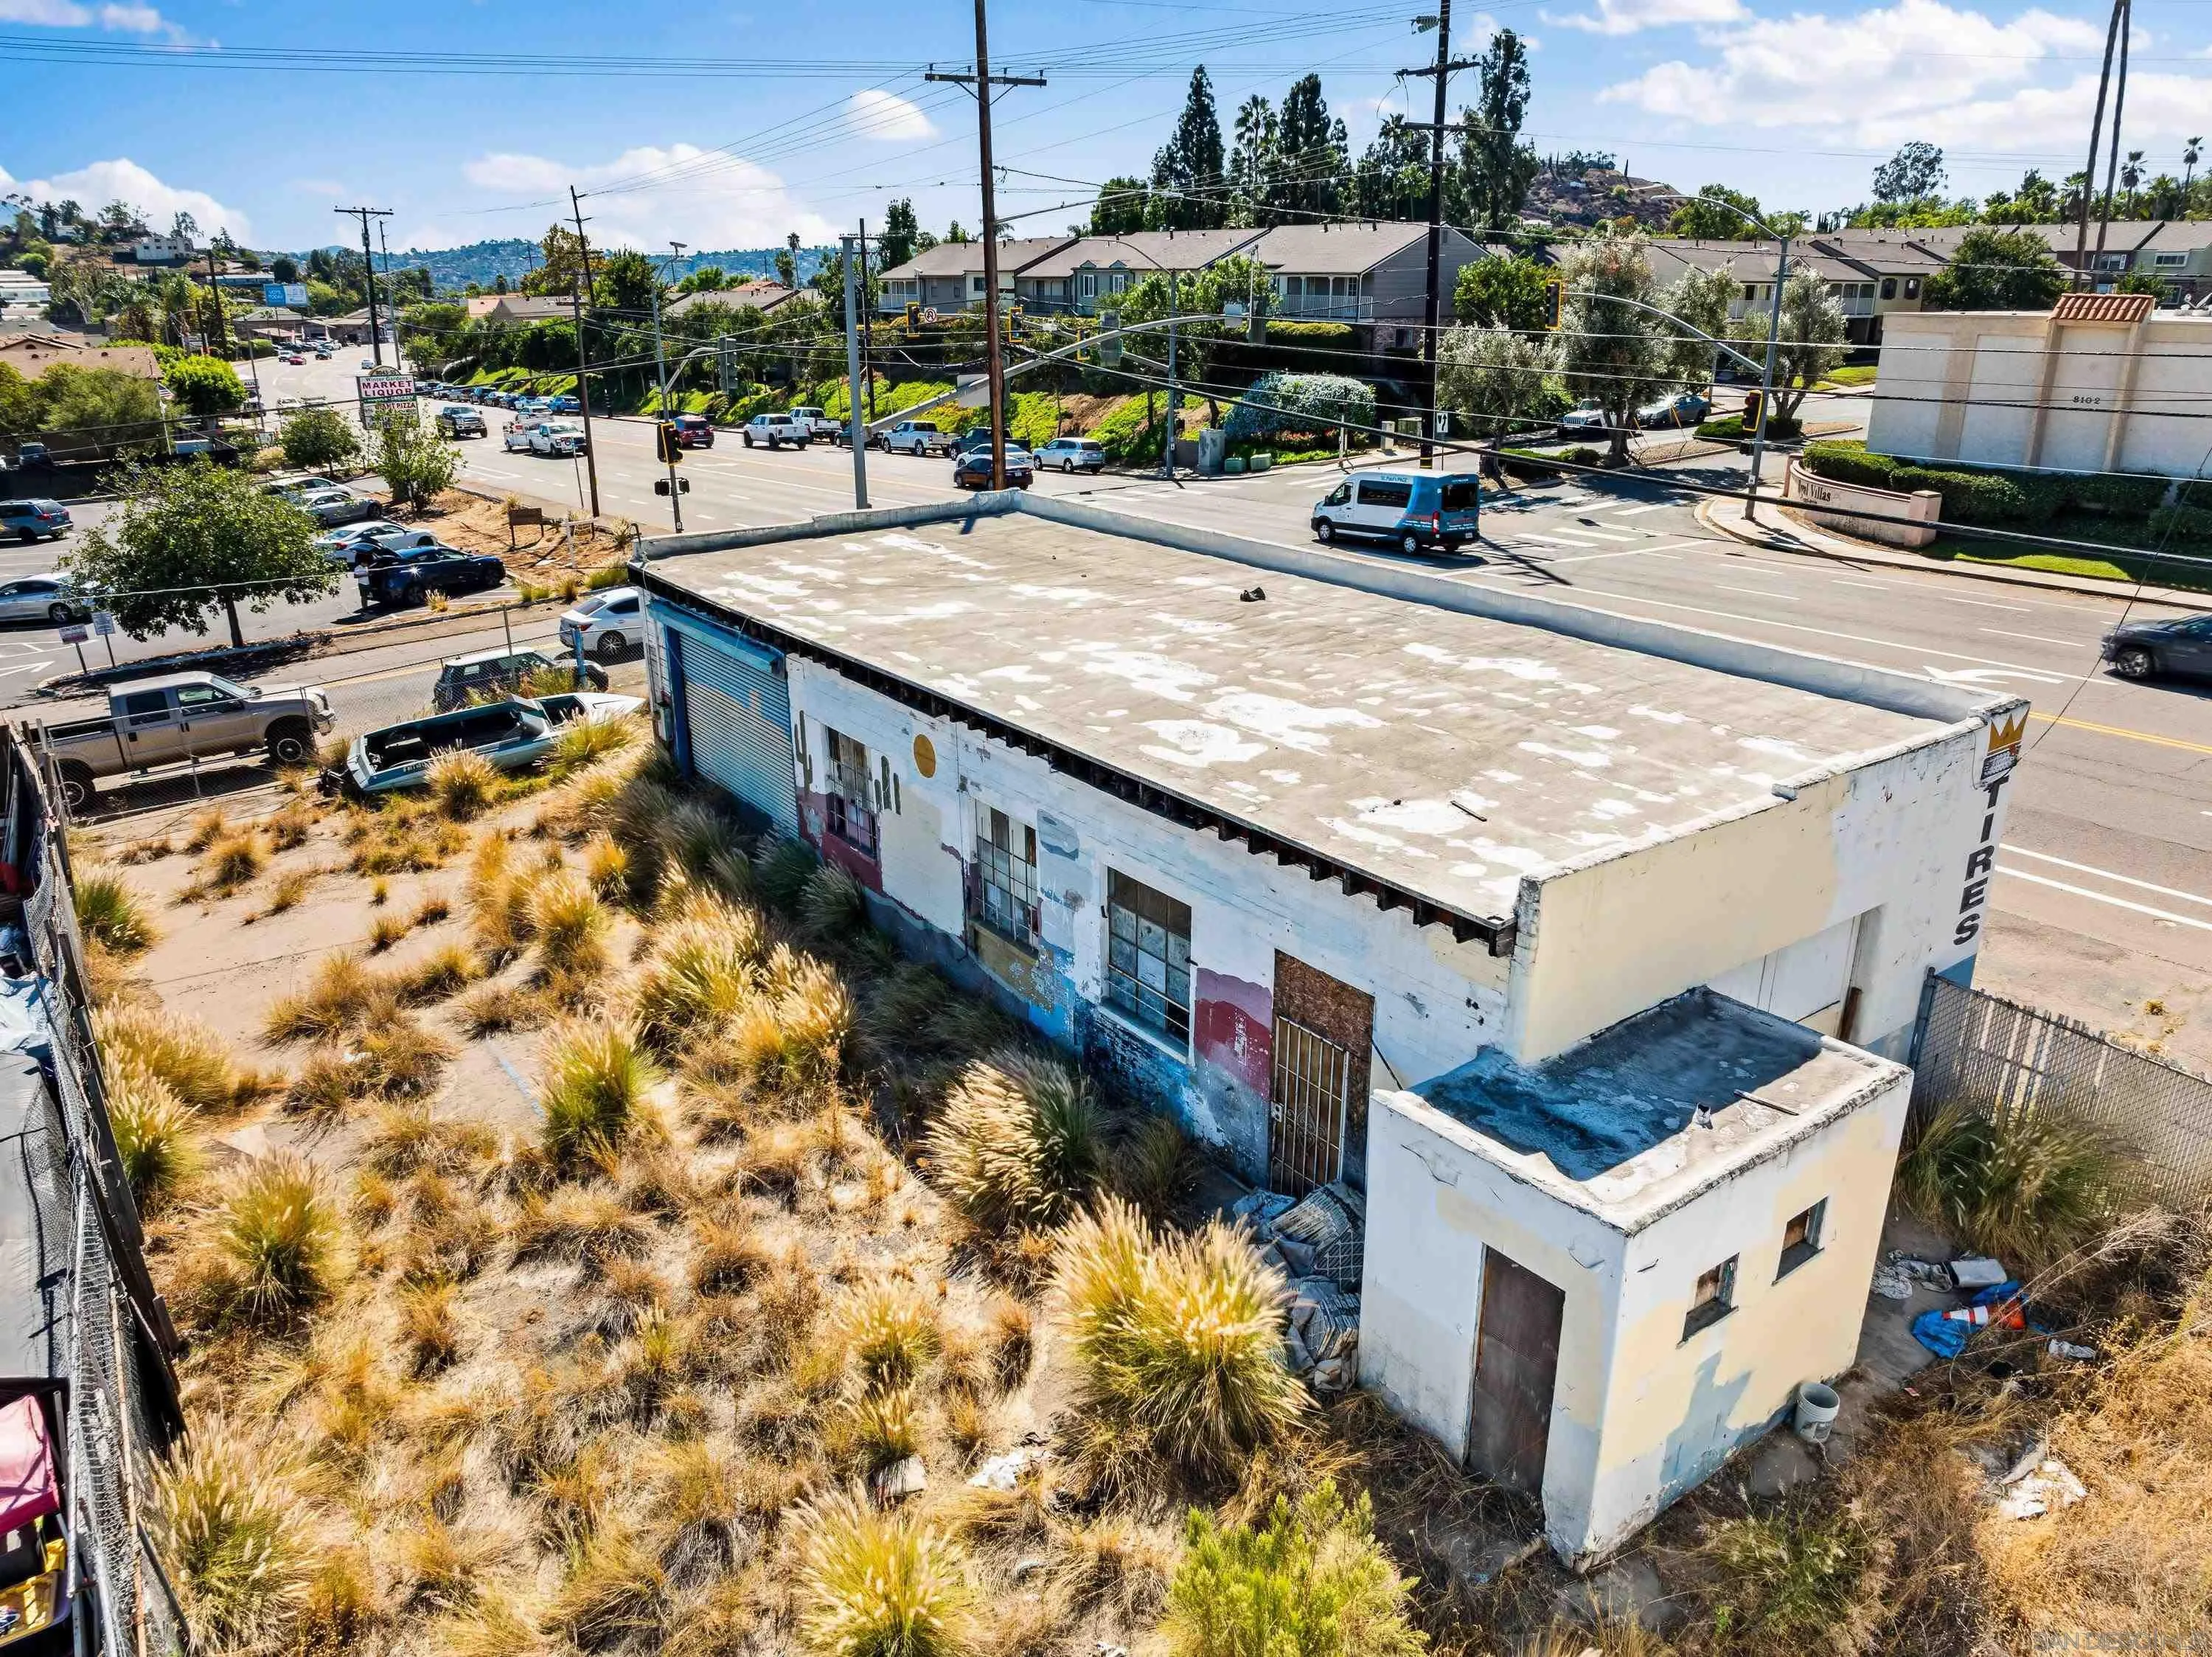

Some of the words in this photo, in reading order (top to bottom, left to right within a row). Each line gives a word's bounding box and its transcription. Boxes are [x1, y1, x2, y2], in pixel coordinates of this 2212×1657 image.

[362, 380, 412, 389] MARKET
[364, 388, 412, 397] LIQUOR
[2073, 395, 2101, 404] 8102
[1811, 484, 1831, 502] Villas
[1953, 774, 2009, 945] TIRES
